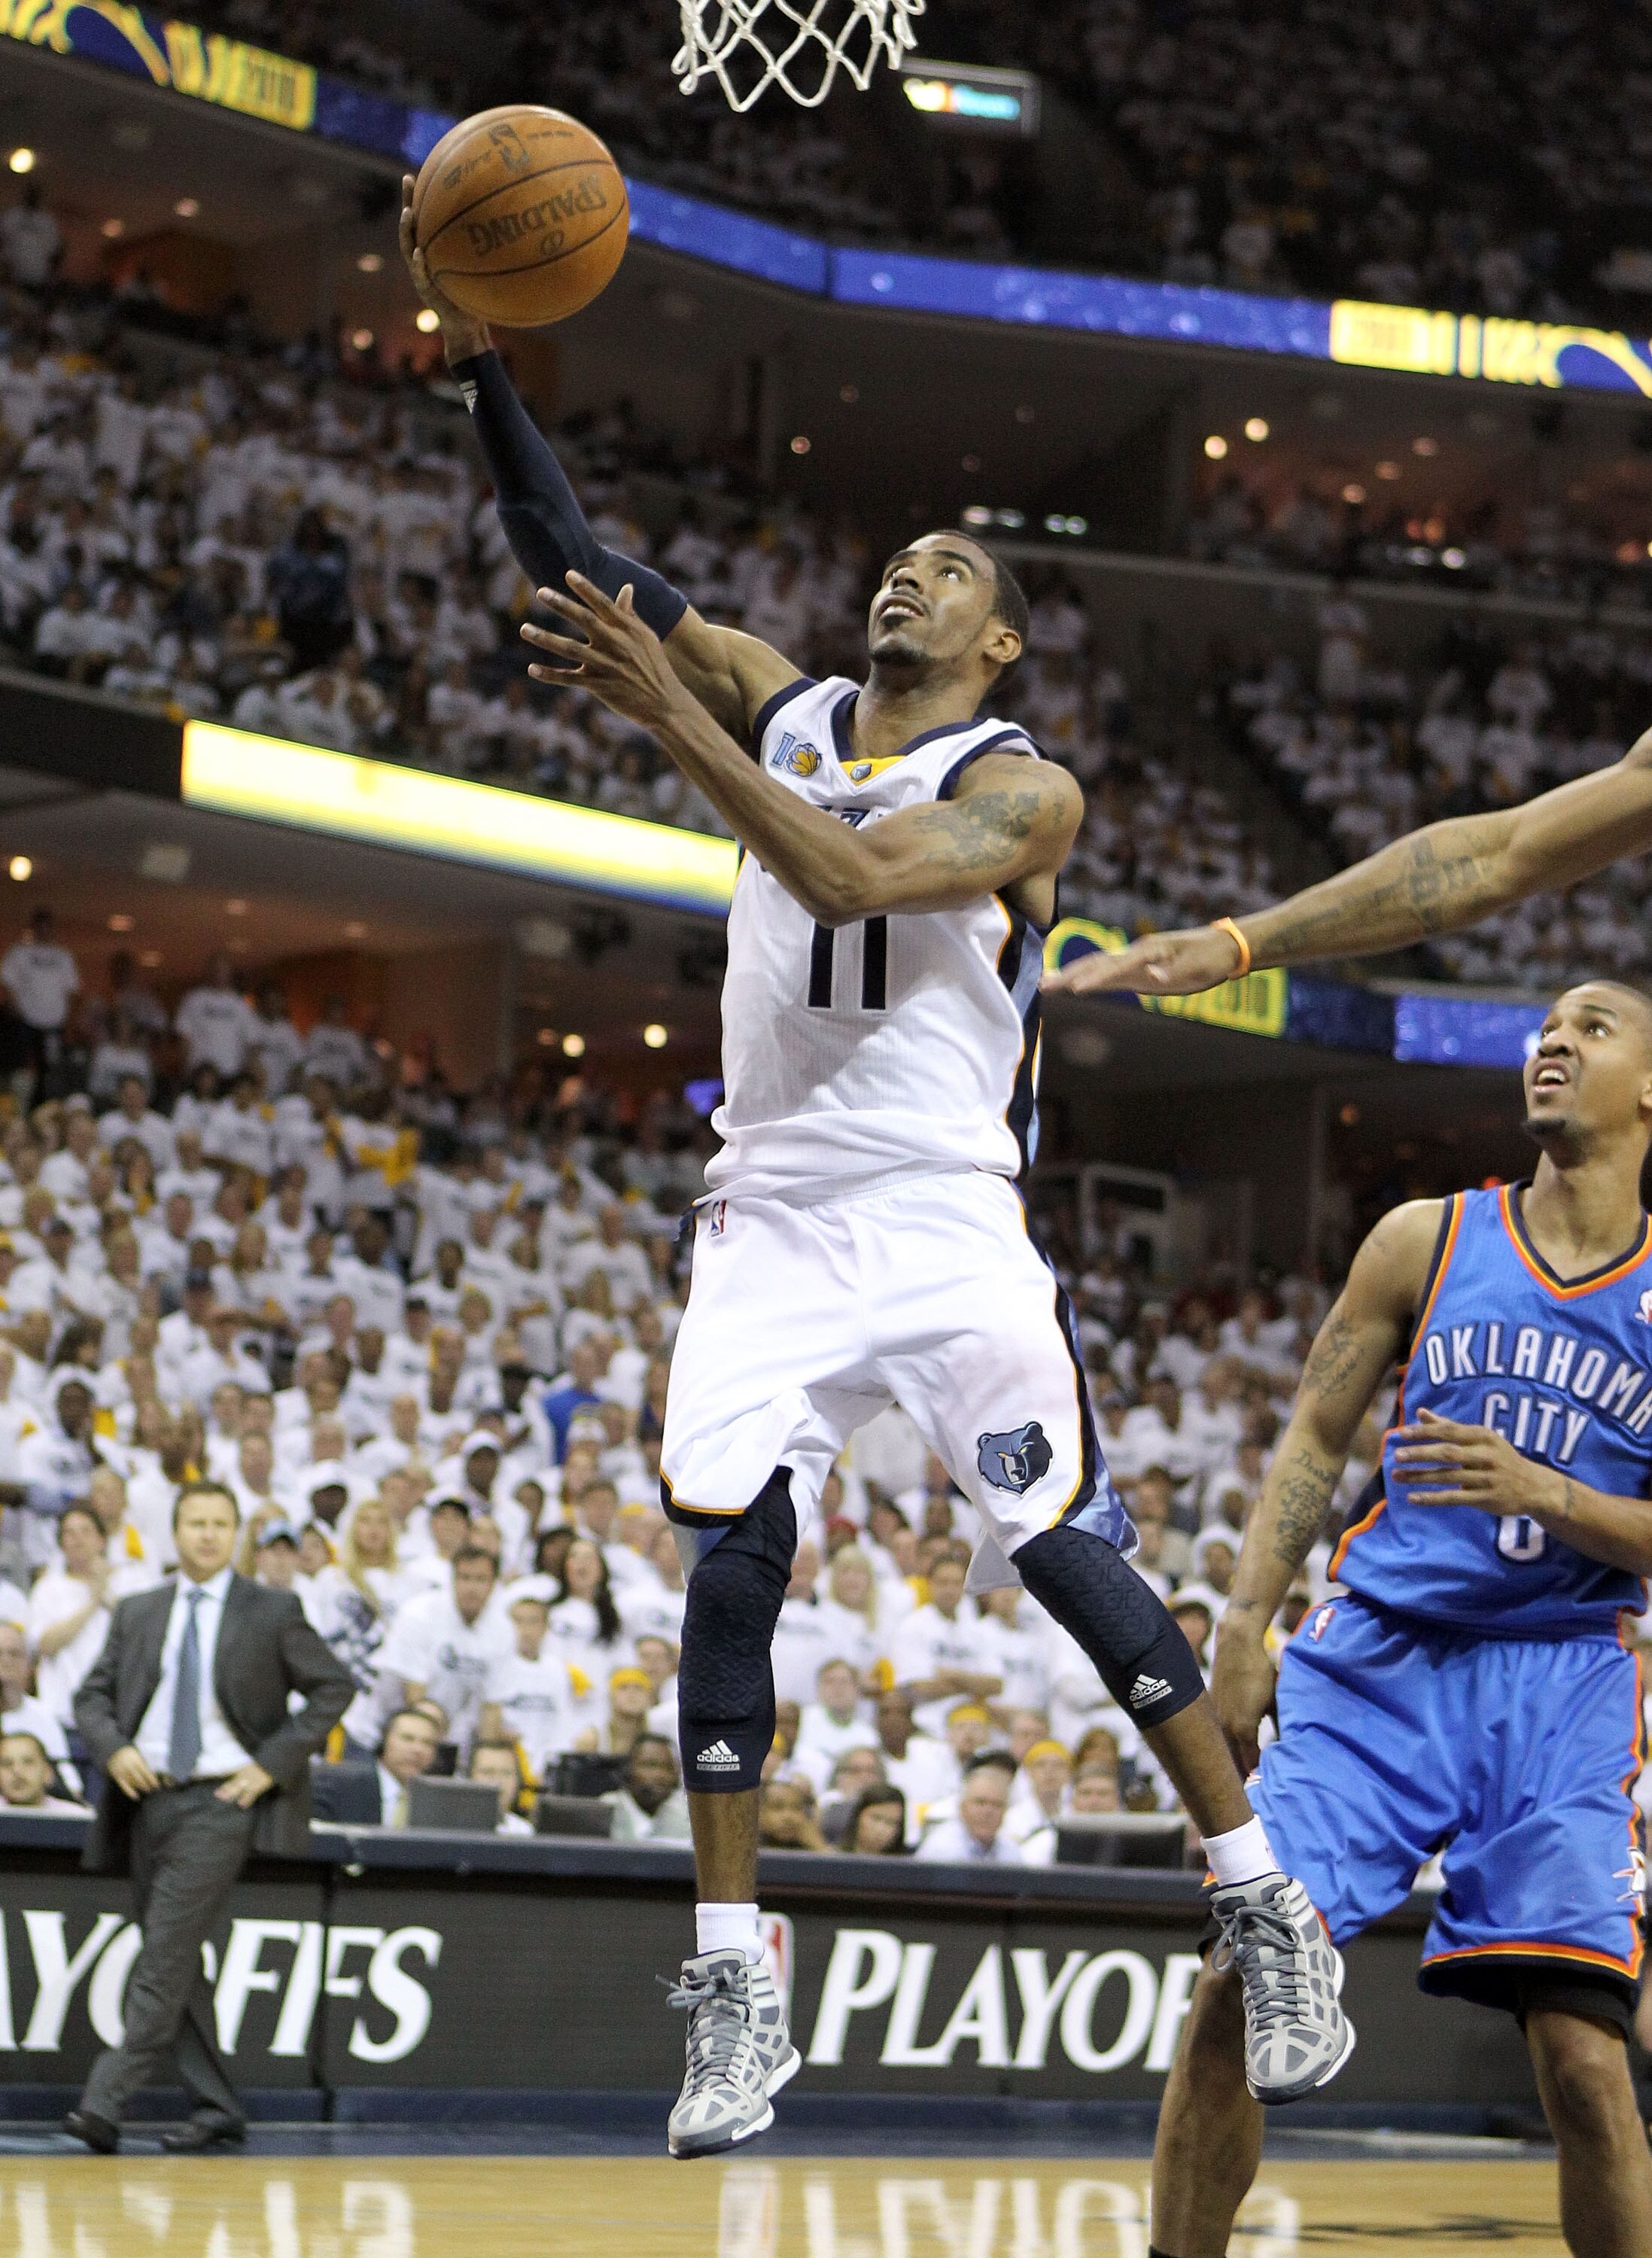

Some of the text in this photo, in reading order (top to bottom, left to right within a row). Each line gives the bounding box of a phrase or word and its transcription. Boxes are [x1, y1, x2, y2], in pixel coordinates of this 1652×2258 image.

[464, 173, 607, 257] SPALDING
[808, 914, 887, 1010] 11
[1484, 1392, 1590, 1463] CITY
[1129, 1678, 1168, 1702] adidas
[696, 1753, 739, 1763] adidas
